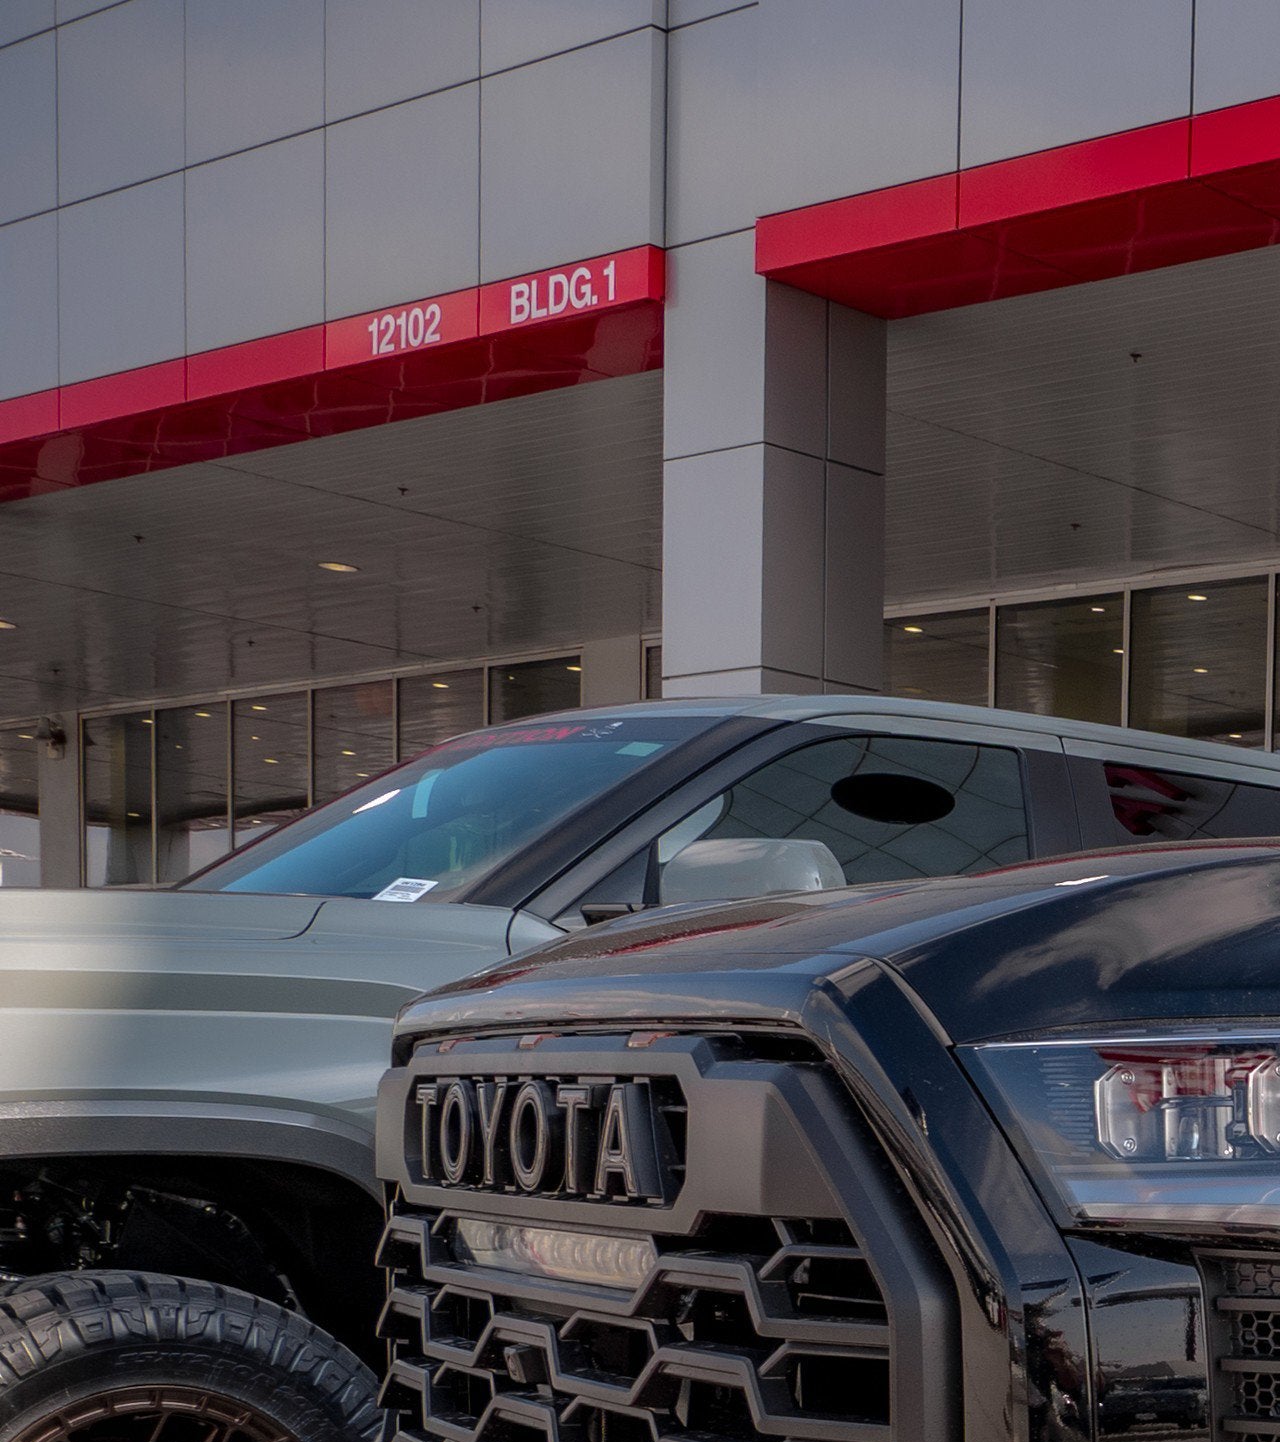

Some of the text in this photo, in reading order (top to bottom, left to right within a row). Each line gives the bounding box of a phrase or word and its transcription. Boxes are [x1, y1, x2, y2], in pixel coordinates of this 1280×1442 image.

[510, 260, 615, 324] BLDG. 1
[368, 303, 441, 354] 12102
[415, 1079, 642, 1199] TOYOTA
